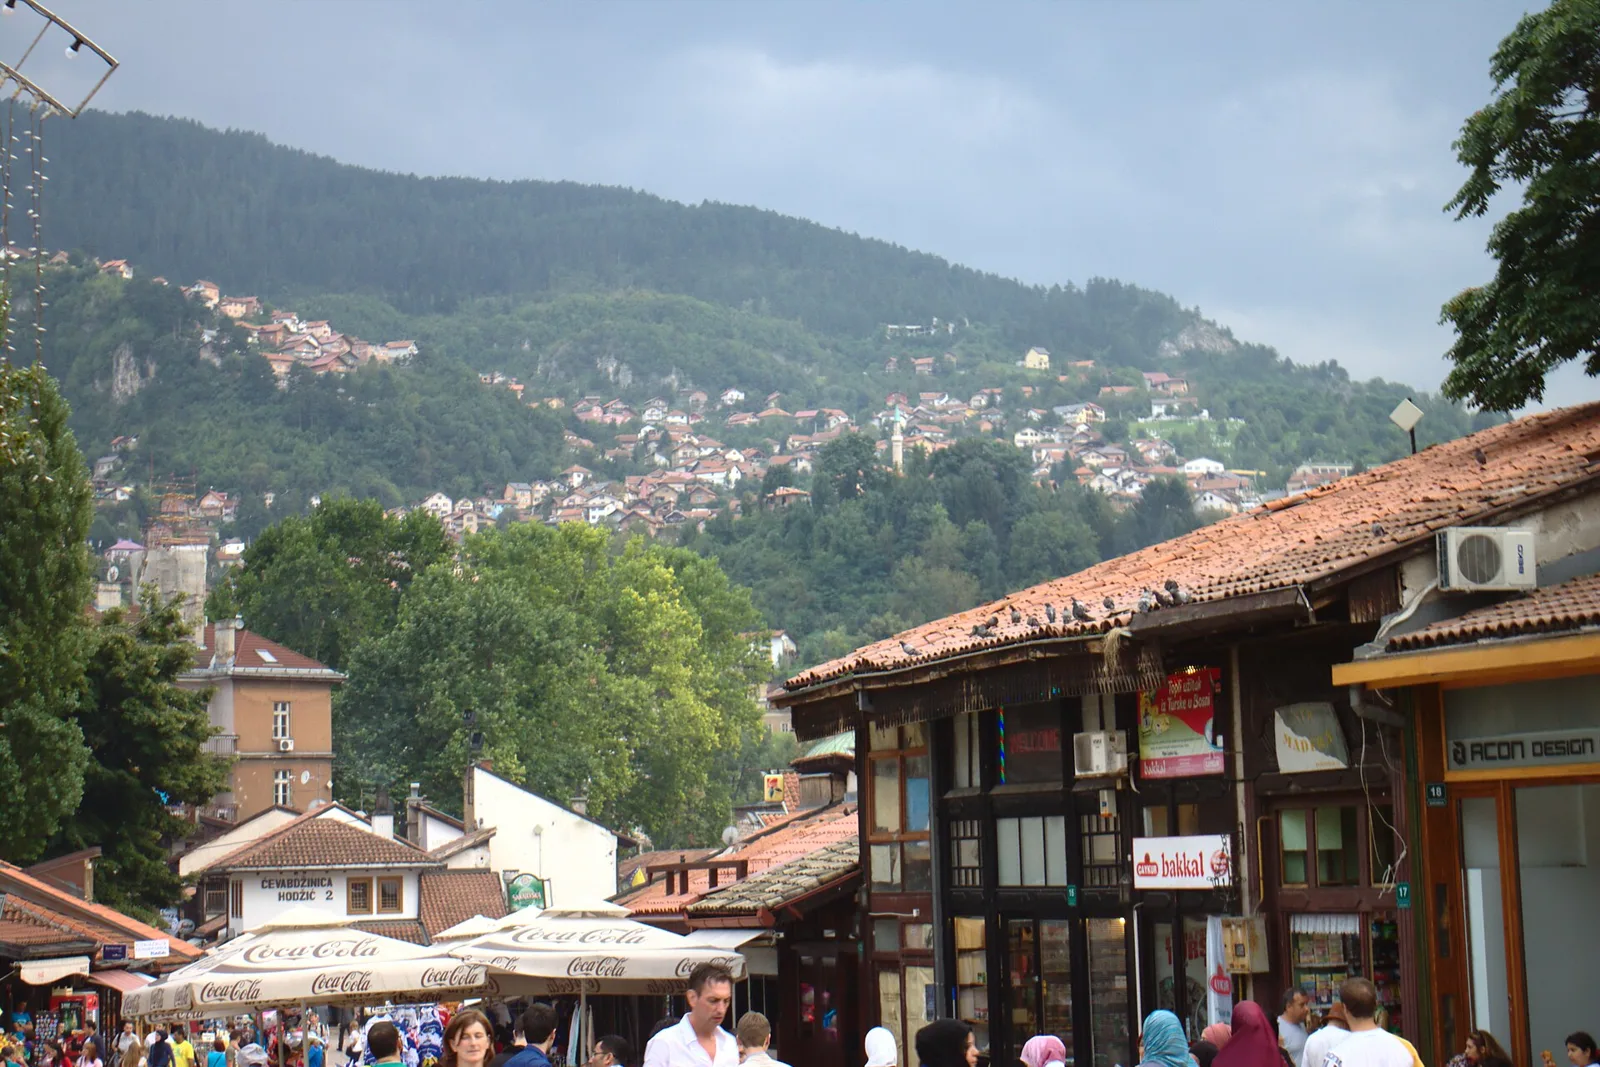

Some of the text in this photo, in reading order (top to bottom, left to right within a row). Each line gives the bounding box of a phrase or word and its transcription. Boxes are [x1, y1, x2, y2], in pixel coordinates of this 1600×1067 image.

[1470, 738, 1594, 761] ACON DESIGN
[1430, 786, 1442, 797] 18
[1161, 850, 1205, 878] bakkal
[278, 889, 334, 901] HODŽIĆ 2
[1399, 887, 1408, 898] 17
